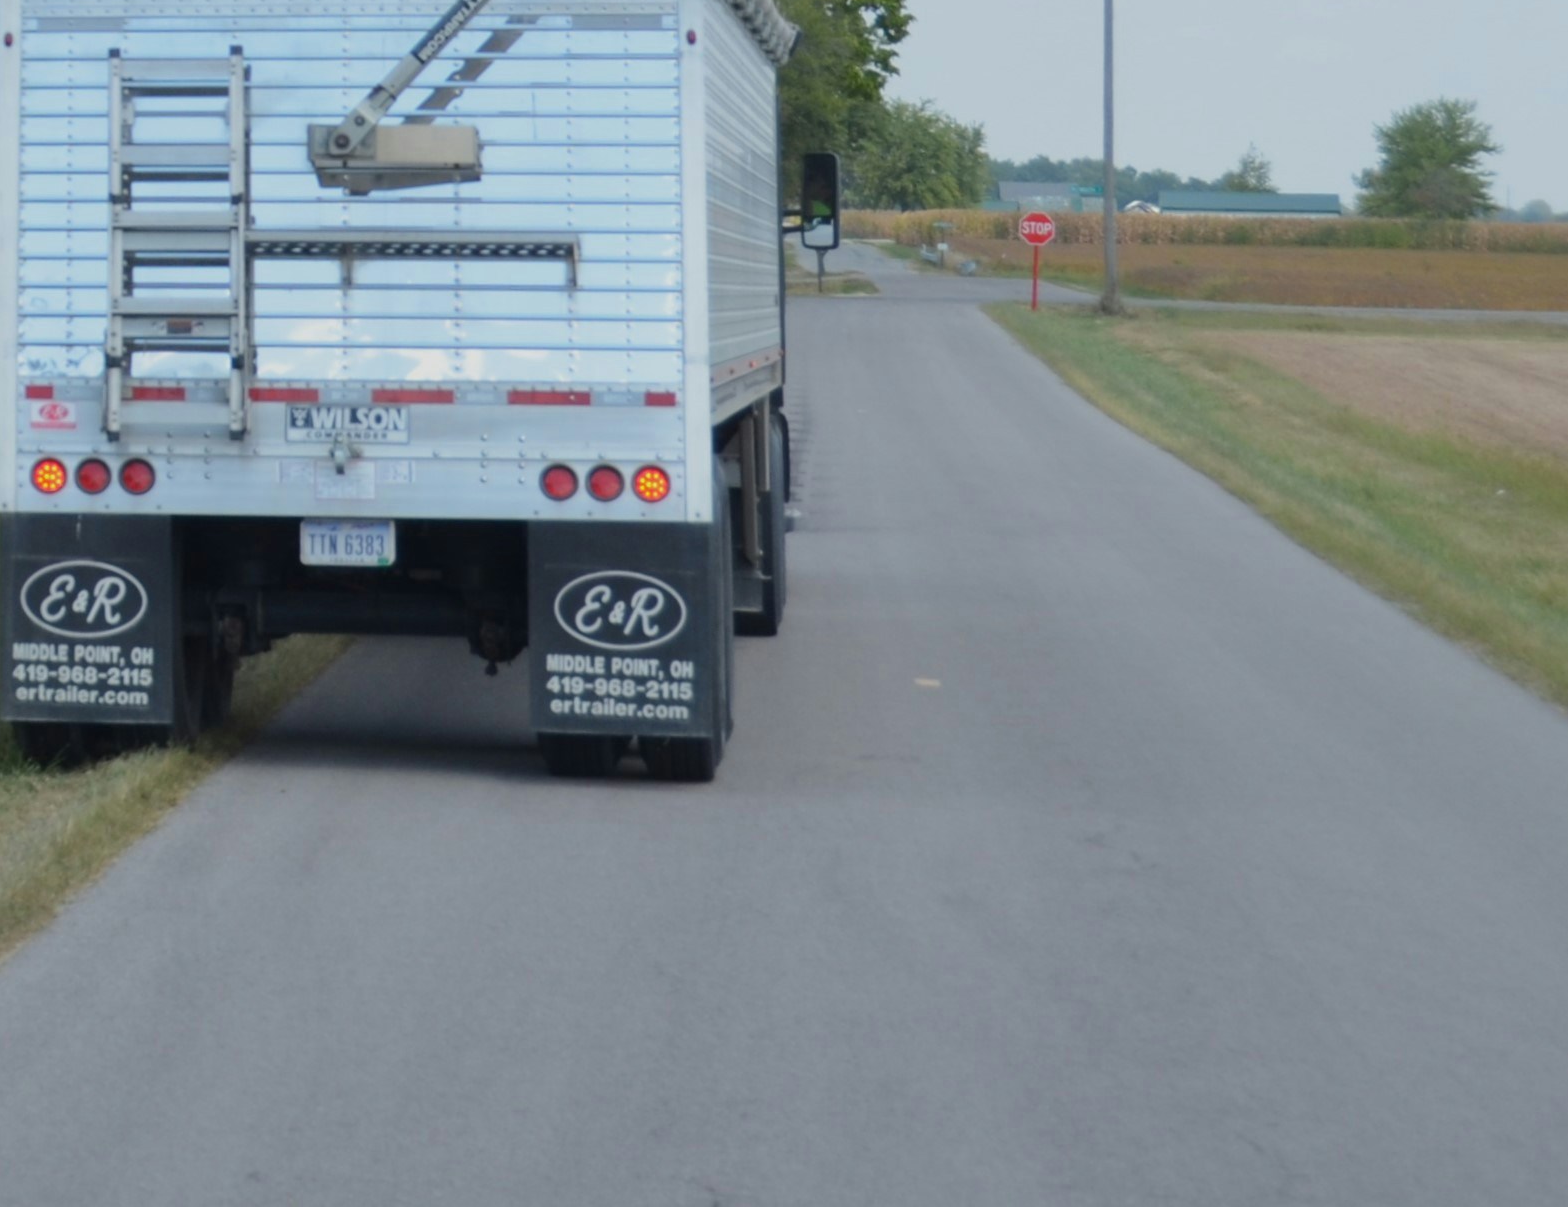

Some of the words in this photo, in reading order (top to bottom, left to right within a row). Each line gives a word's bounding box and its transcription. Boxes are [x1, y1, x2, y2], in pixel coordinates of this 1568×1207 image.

[1022, 221, 1052, 234] STOP
[313, 407, 406, 430] WILSON
[308, 533, 338, 556] TTN
[345, 533, 384, 556] 6383
[13, 643, 69, 662] MIDDLE
[74, 644, 125, 667] POINT,
[130, 646, 154, 665] OH
[546, 653, 605, 674] MIDDLE
[611, 657, 664, 680] POINT,
[670, 660, 694, 679] OH
[12, 664, 153, 686] 419-968-2115
[15, 684, 149, 705] ertrailer.com
[546, 675, 694, 701] 419-968-2115
[550, 696, 689, 719] ertrailer.com
